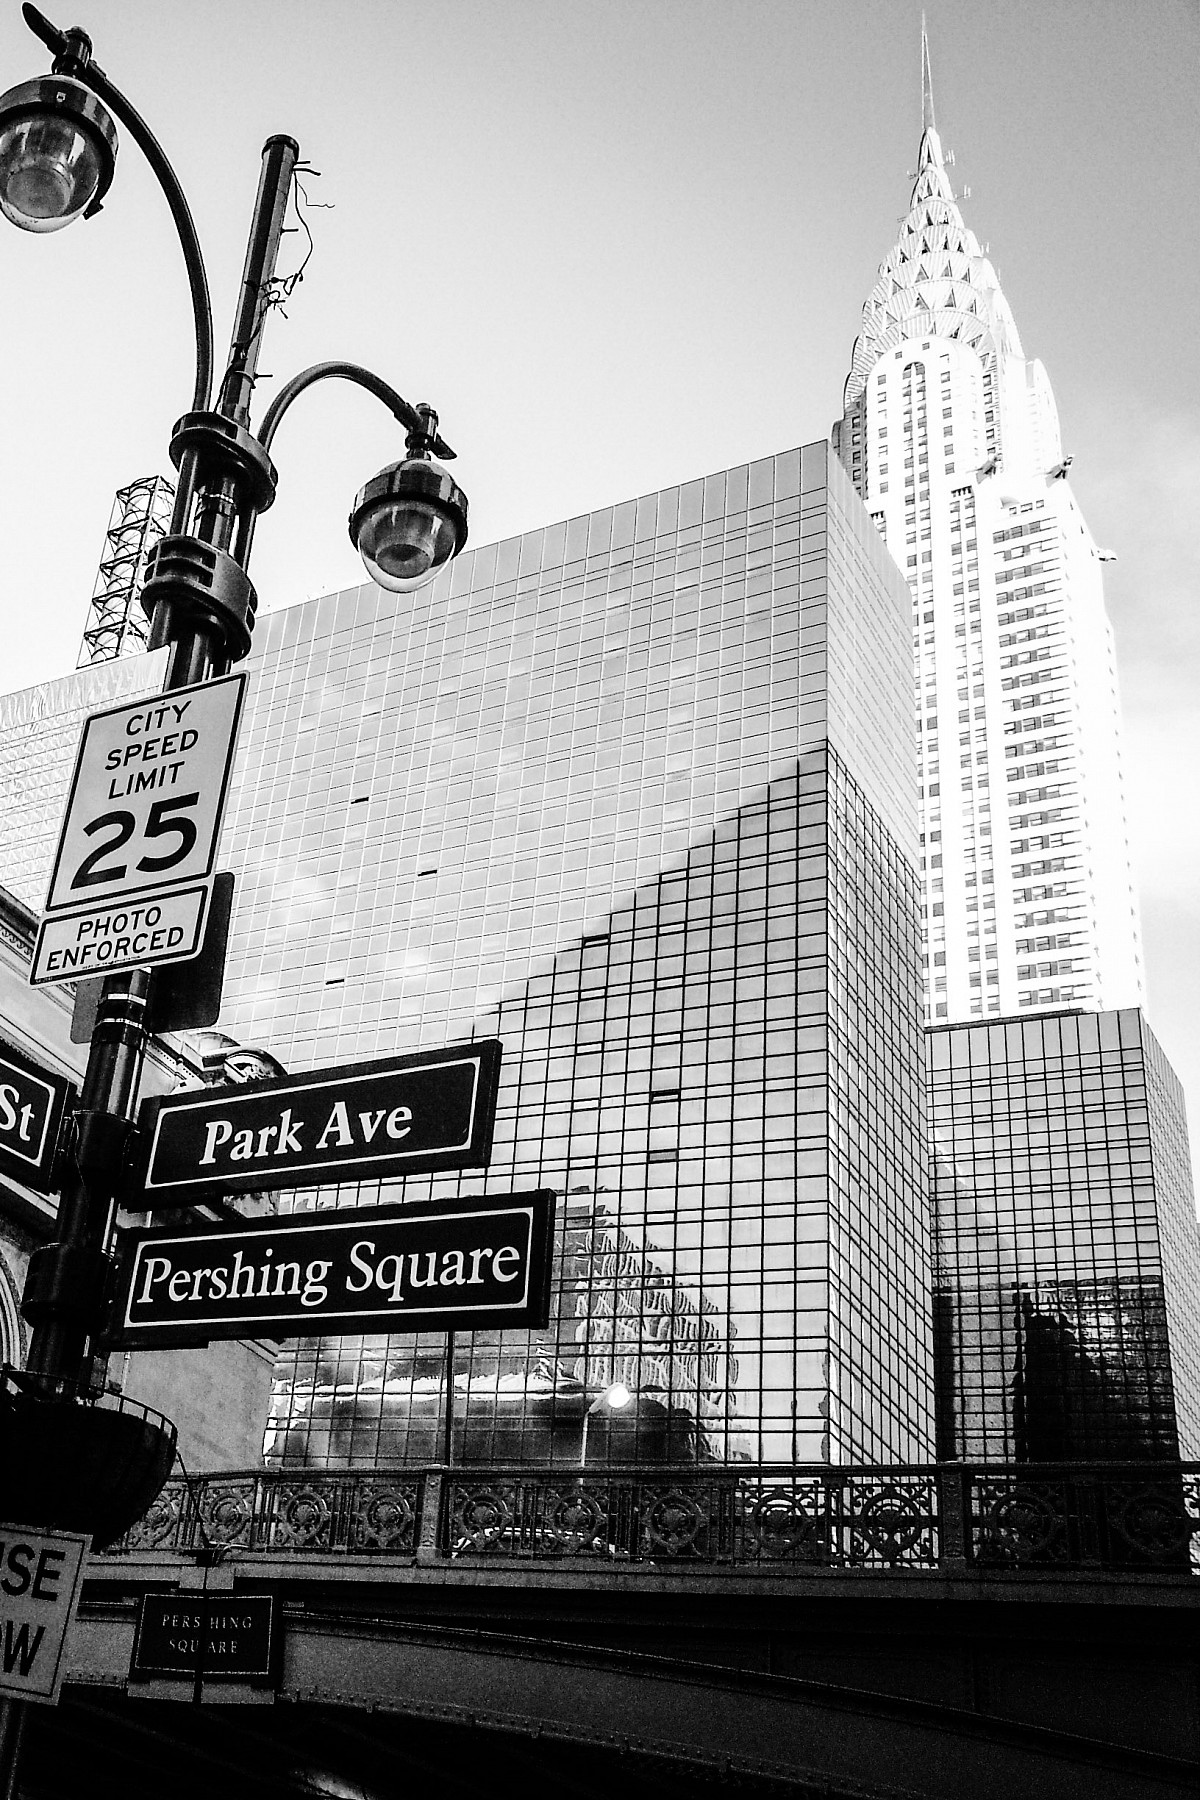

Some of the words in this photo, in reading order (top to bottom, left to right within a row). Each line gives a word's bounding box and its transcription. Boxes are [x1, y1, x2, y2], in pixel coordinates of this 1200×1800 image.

[125, 700, 192, 735] CITY
[104, 729, 199, 771] SPEED
[108, 760, 186, 800] LIMIT
[70, 791, 200, 890] 25
[76, 906, 161, 941] PHOTO
[46, 925, 184, 971] ENFORCED
[199, 1108, 304, 1166] Park
[315, 1101, 413, 1150] Ave
[136, 1248, 334, 1307] Pershing
[345, 1241, 521, 1303] Square
